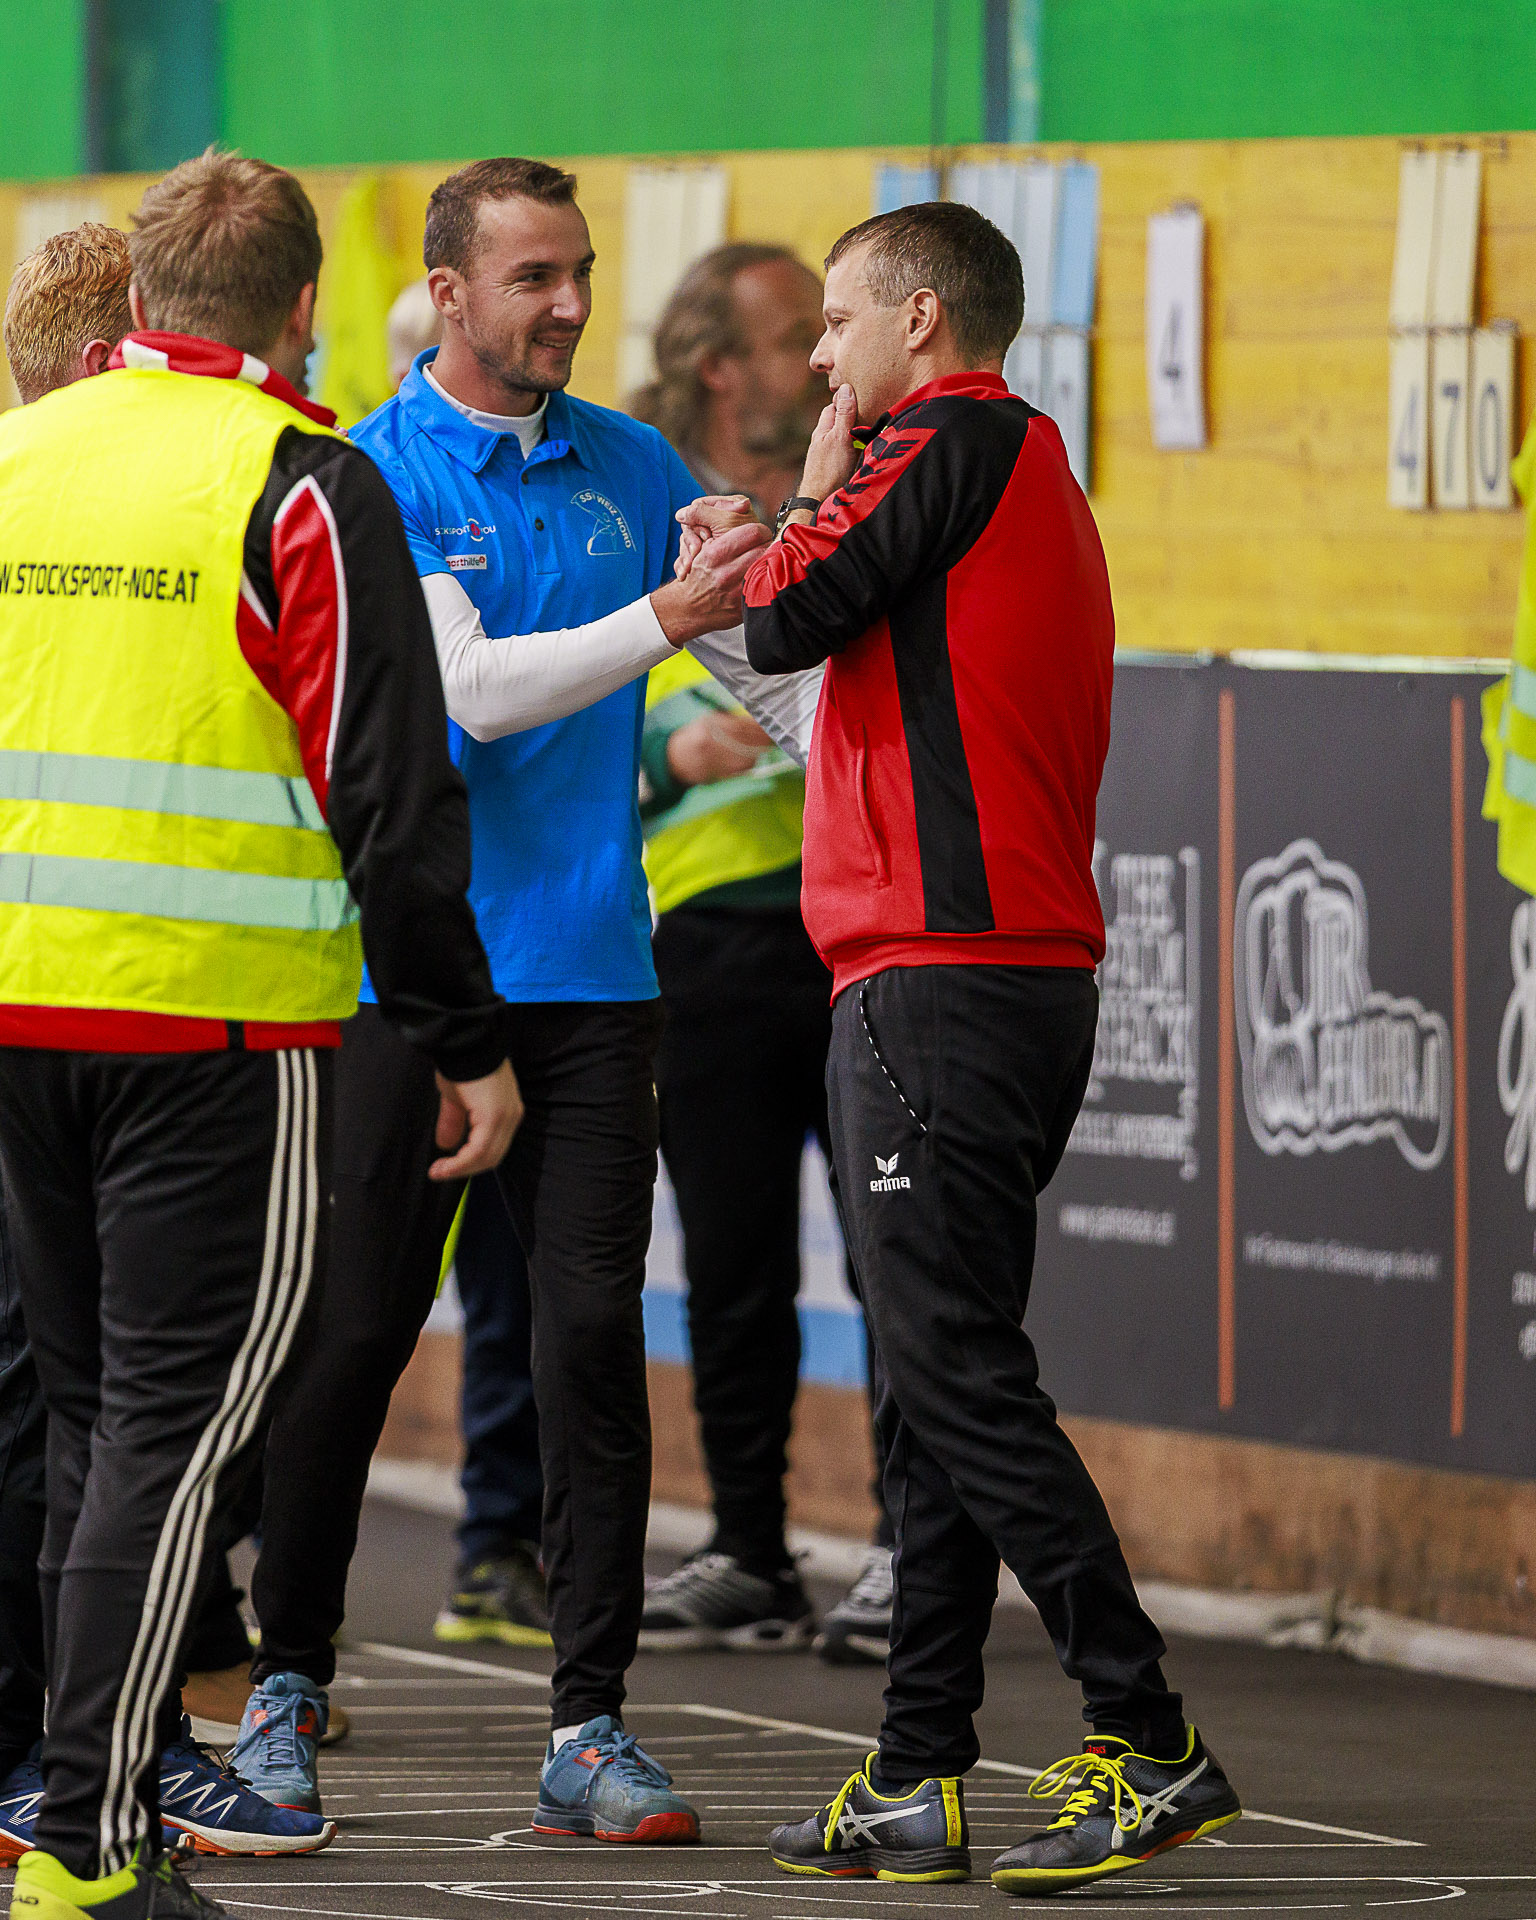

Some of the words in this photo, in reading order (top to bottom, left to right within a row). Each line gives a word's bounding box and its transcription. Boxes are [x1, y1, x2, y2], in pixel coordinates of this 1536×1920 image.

[1158, 303, 1184, 398] 4
[1397, 382, 1502, 494] 470
[616, 517, 632, 549] NORD
[869, 1175, 911, 1192] erima
